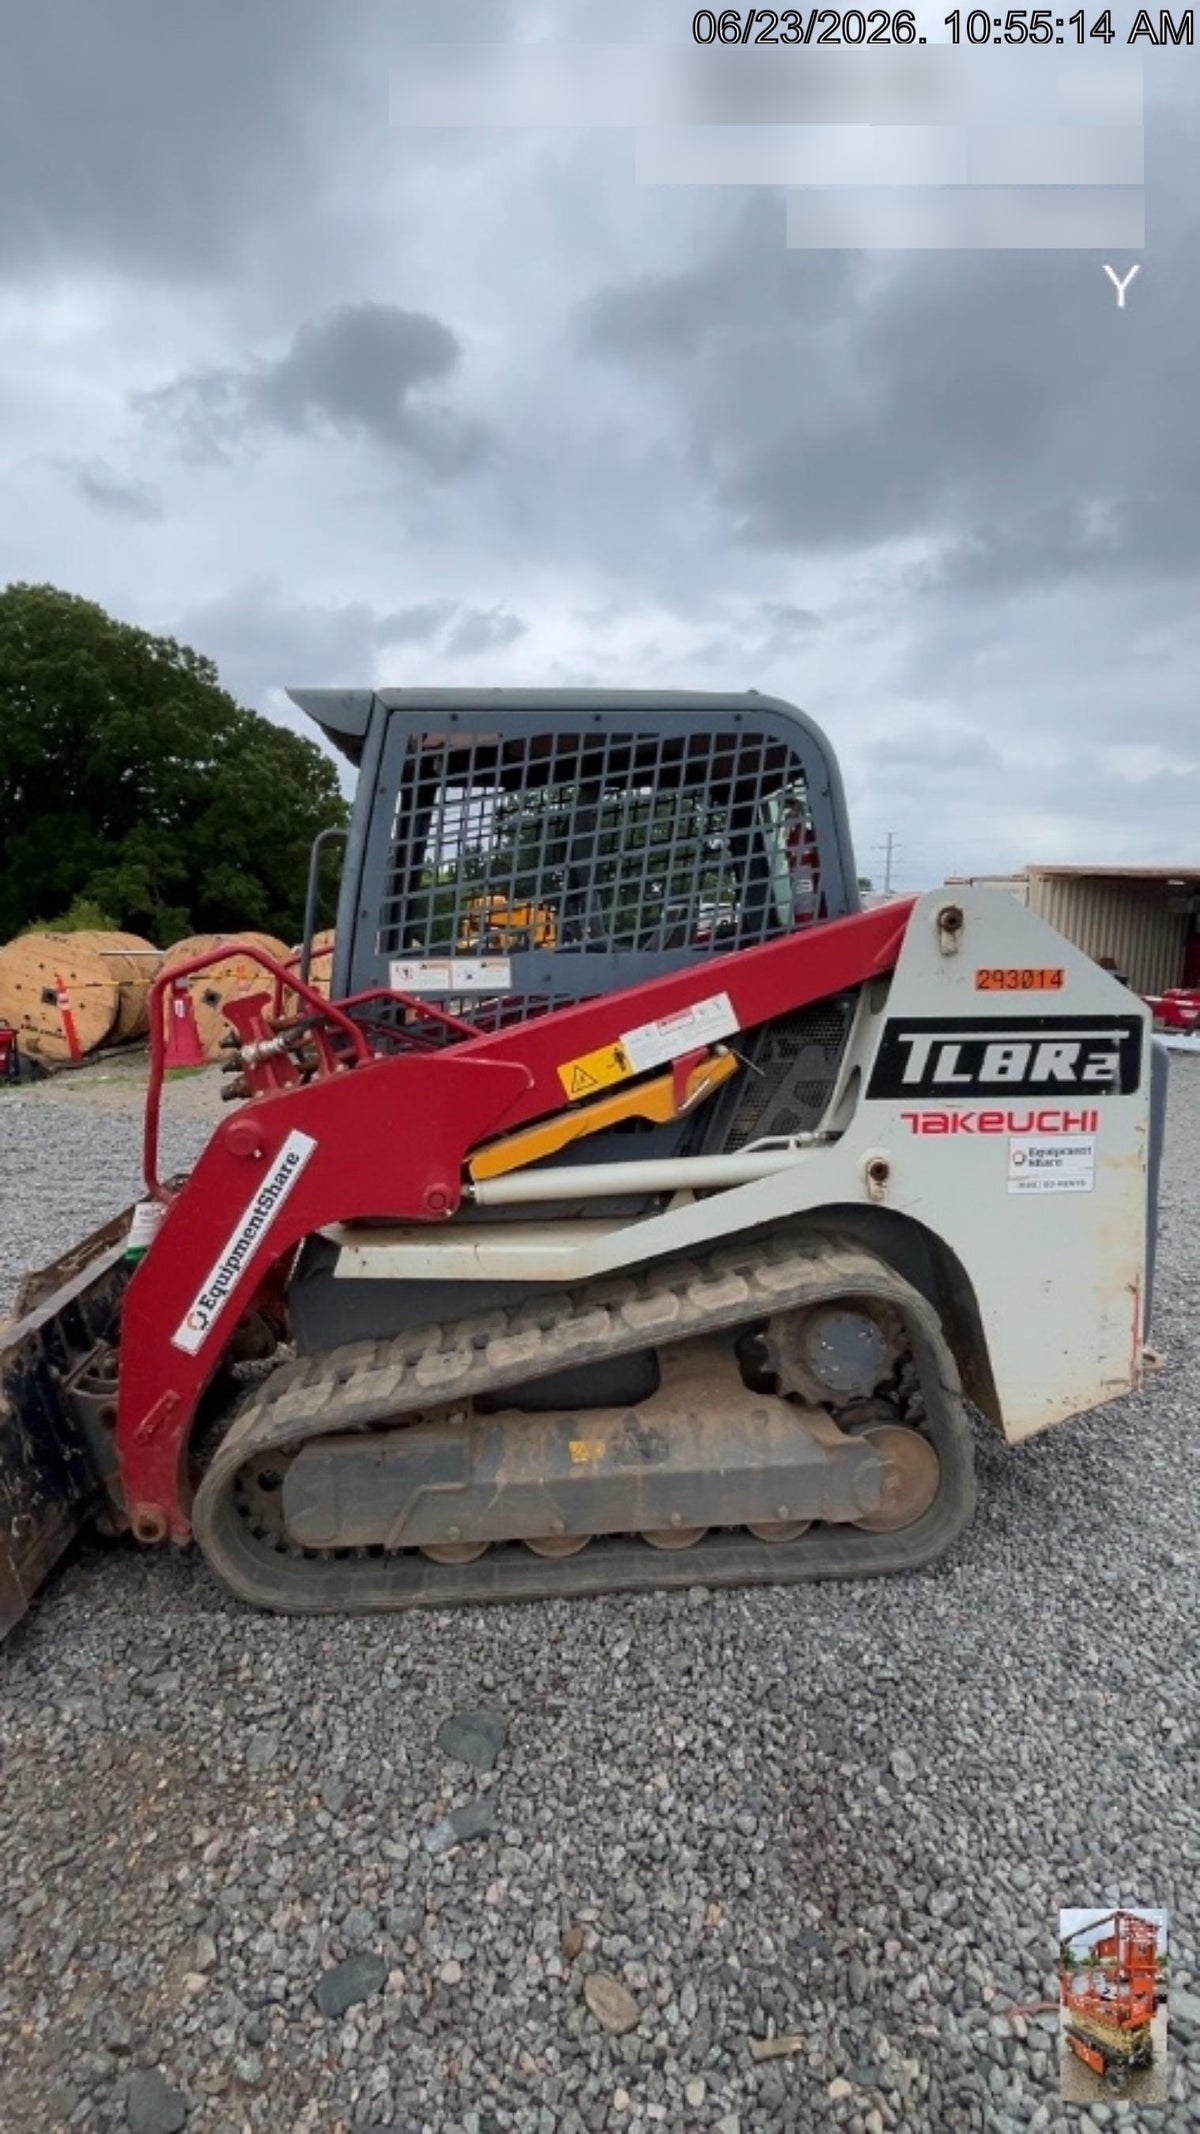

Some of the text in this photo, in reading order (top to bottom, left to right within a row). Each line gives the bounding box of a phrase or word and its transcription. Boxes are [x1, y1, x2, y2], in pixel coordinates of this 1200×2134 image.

[976, 969, 1063, 990] 293014
[901, 1110, 1098, 1134] TAKEUCHI
[200, 1151, 300, 1312] EquipmentShare
